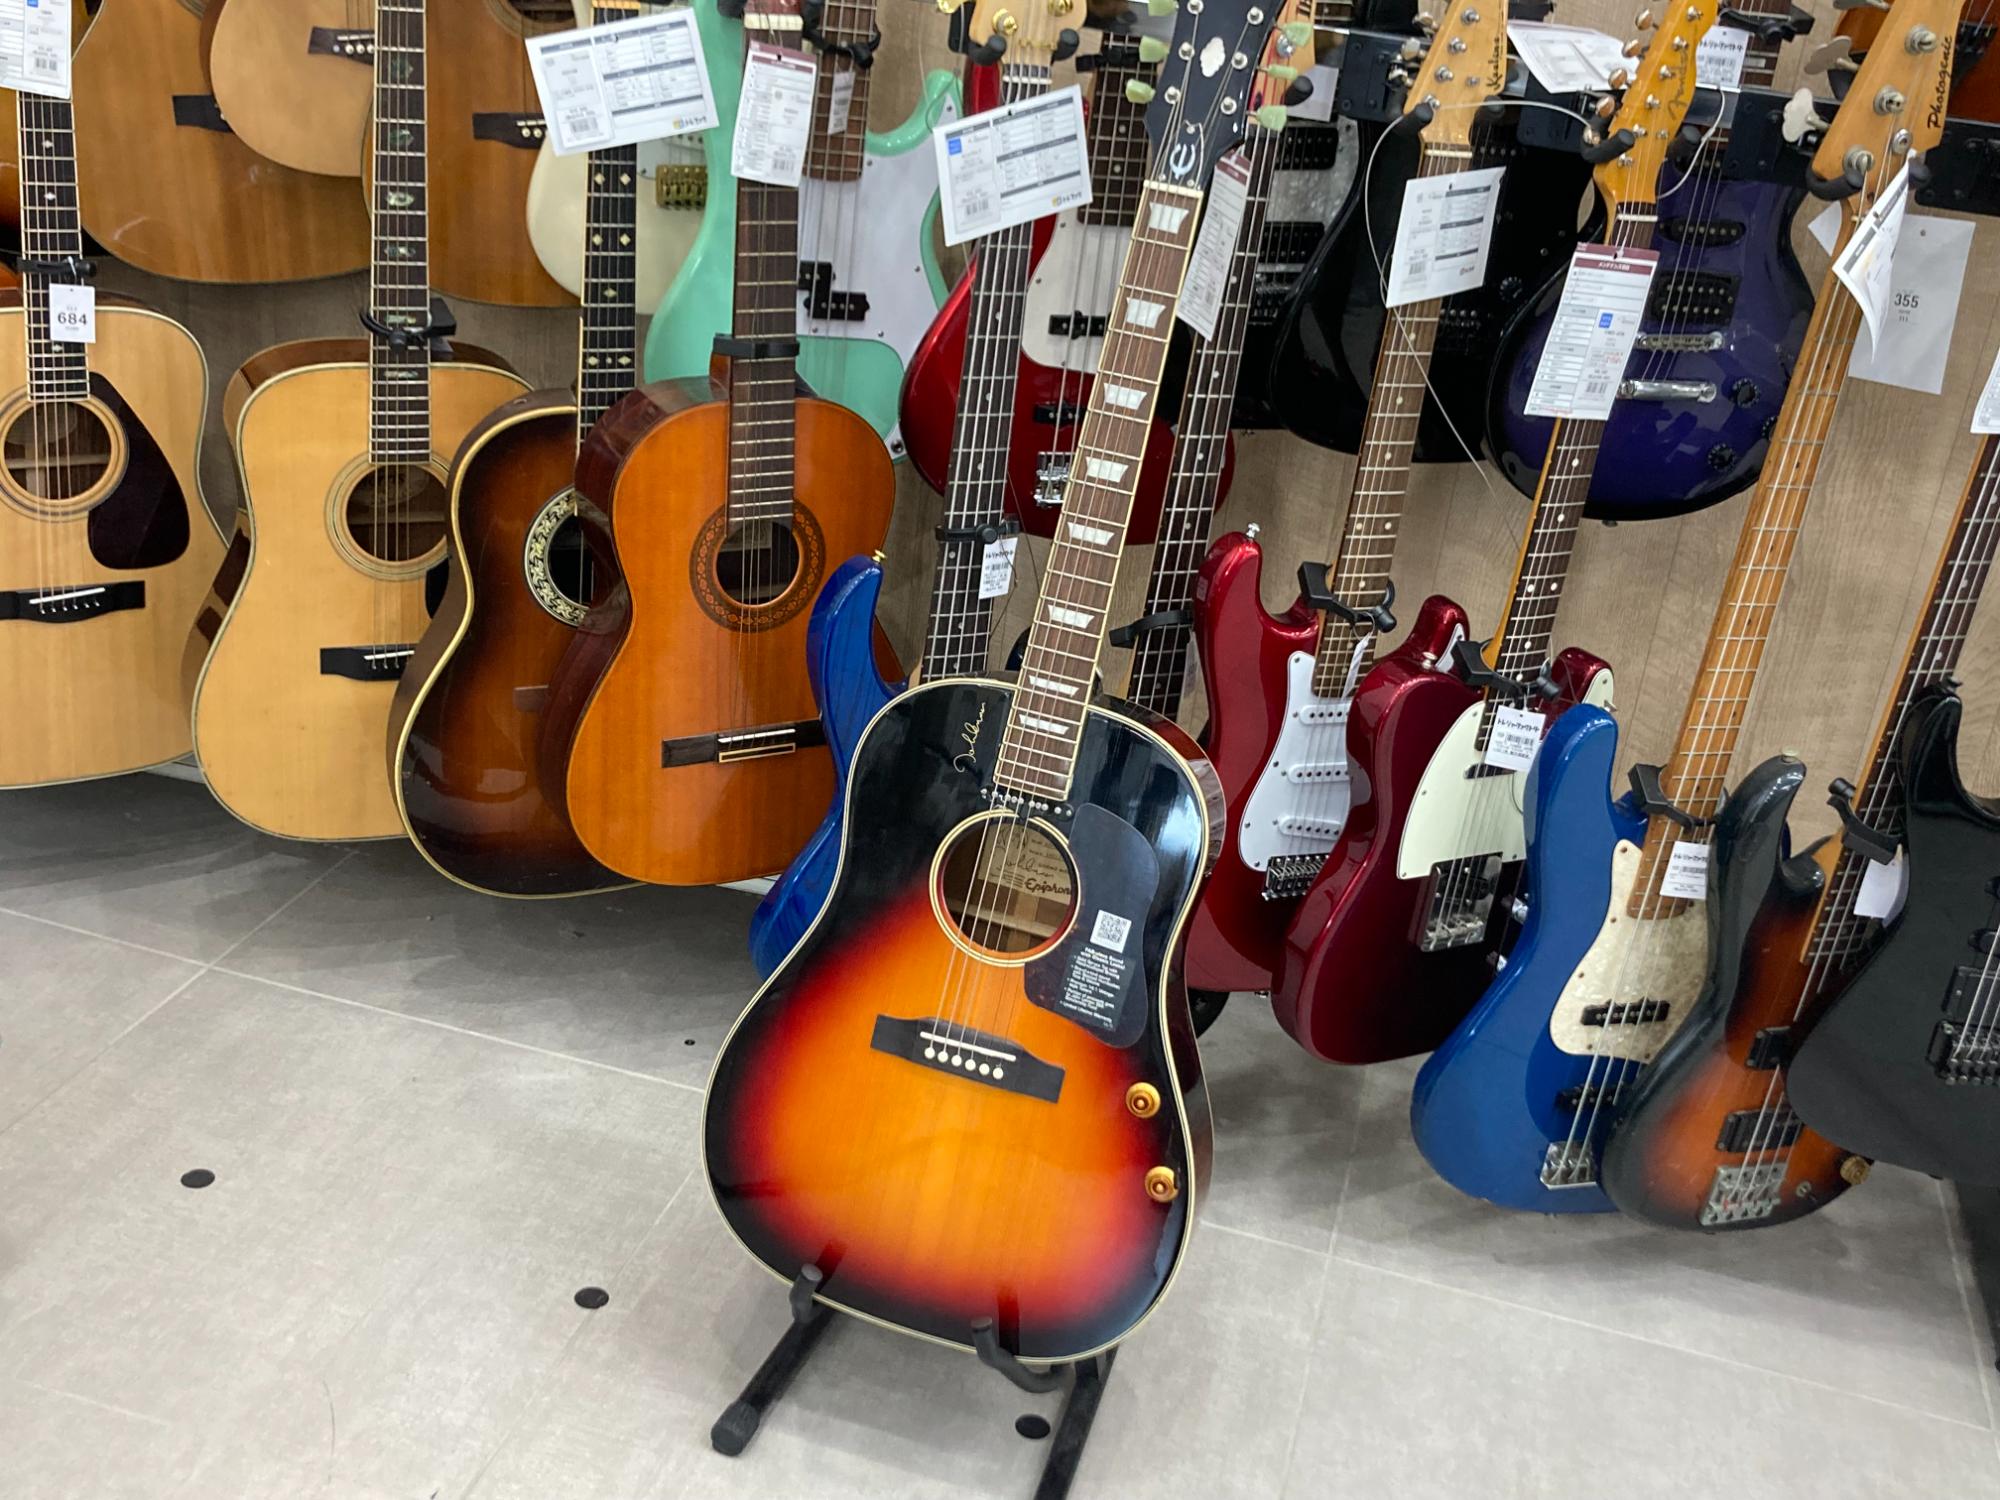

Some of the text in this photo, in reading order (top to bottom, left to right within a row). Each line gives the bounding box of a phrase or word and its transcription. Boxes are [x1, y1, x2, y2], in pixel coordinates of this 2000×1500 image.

[1927, 36, 1953, 129] Photogenic
[1894, 293, 1919, 309] 355
[57, 312, 87, 326] 684
[1024, 877, 1071, 895] Epiphon
